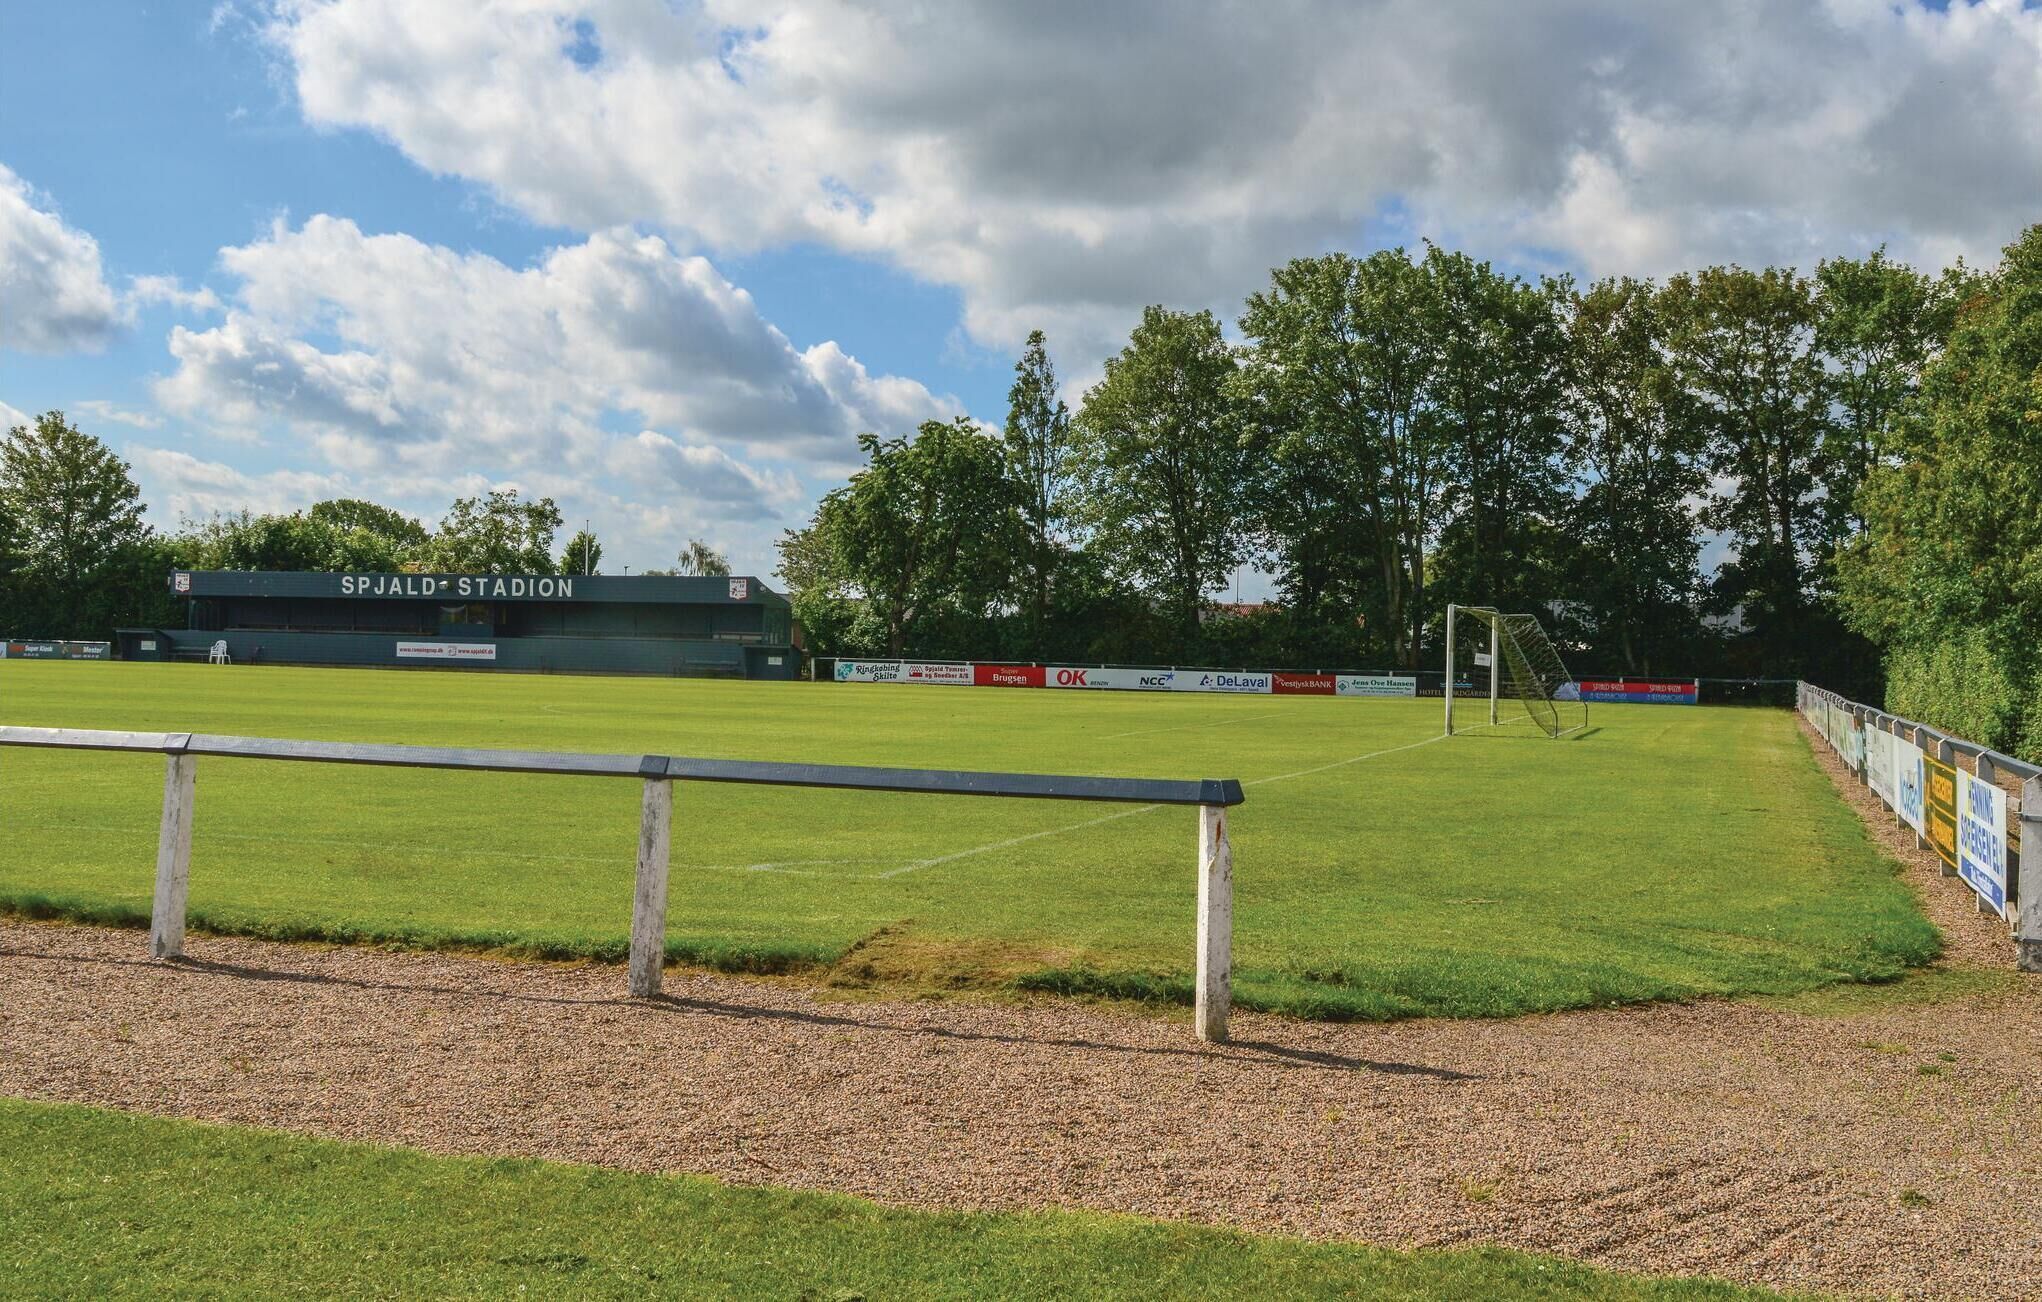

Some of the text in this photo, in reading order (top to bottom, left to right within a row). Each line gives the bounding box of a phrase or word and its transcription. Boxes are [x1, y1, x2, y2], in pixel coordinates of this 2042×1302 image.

[342, 575, 573, 598] SPJALD STADION
[872, 671, 898, 682] Skilte
[992, 673, 1027, 684] Brugsen
[1056, 669, 1088, 686] OK
[1139, 676, 1166, 686] NCC
[1216, 675, 1268, 688] DeLaval
[1351, 679, 1415, 688] Jens Ove Hansen
[1419, 688, 1442, 697] HOTEL
